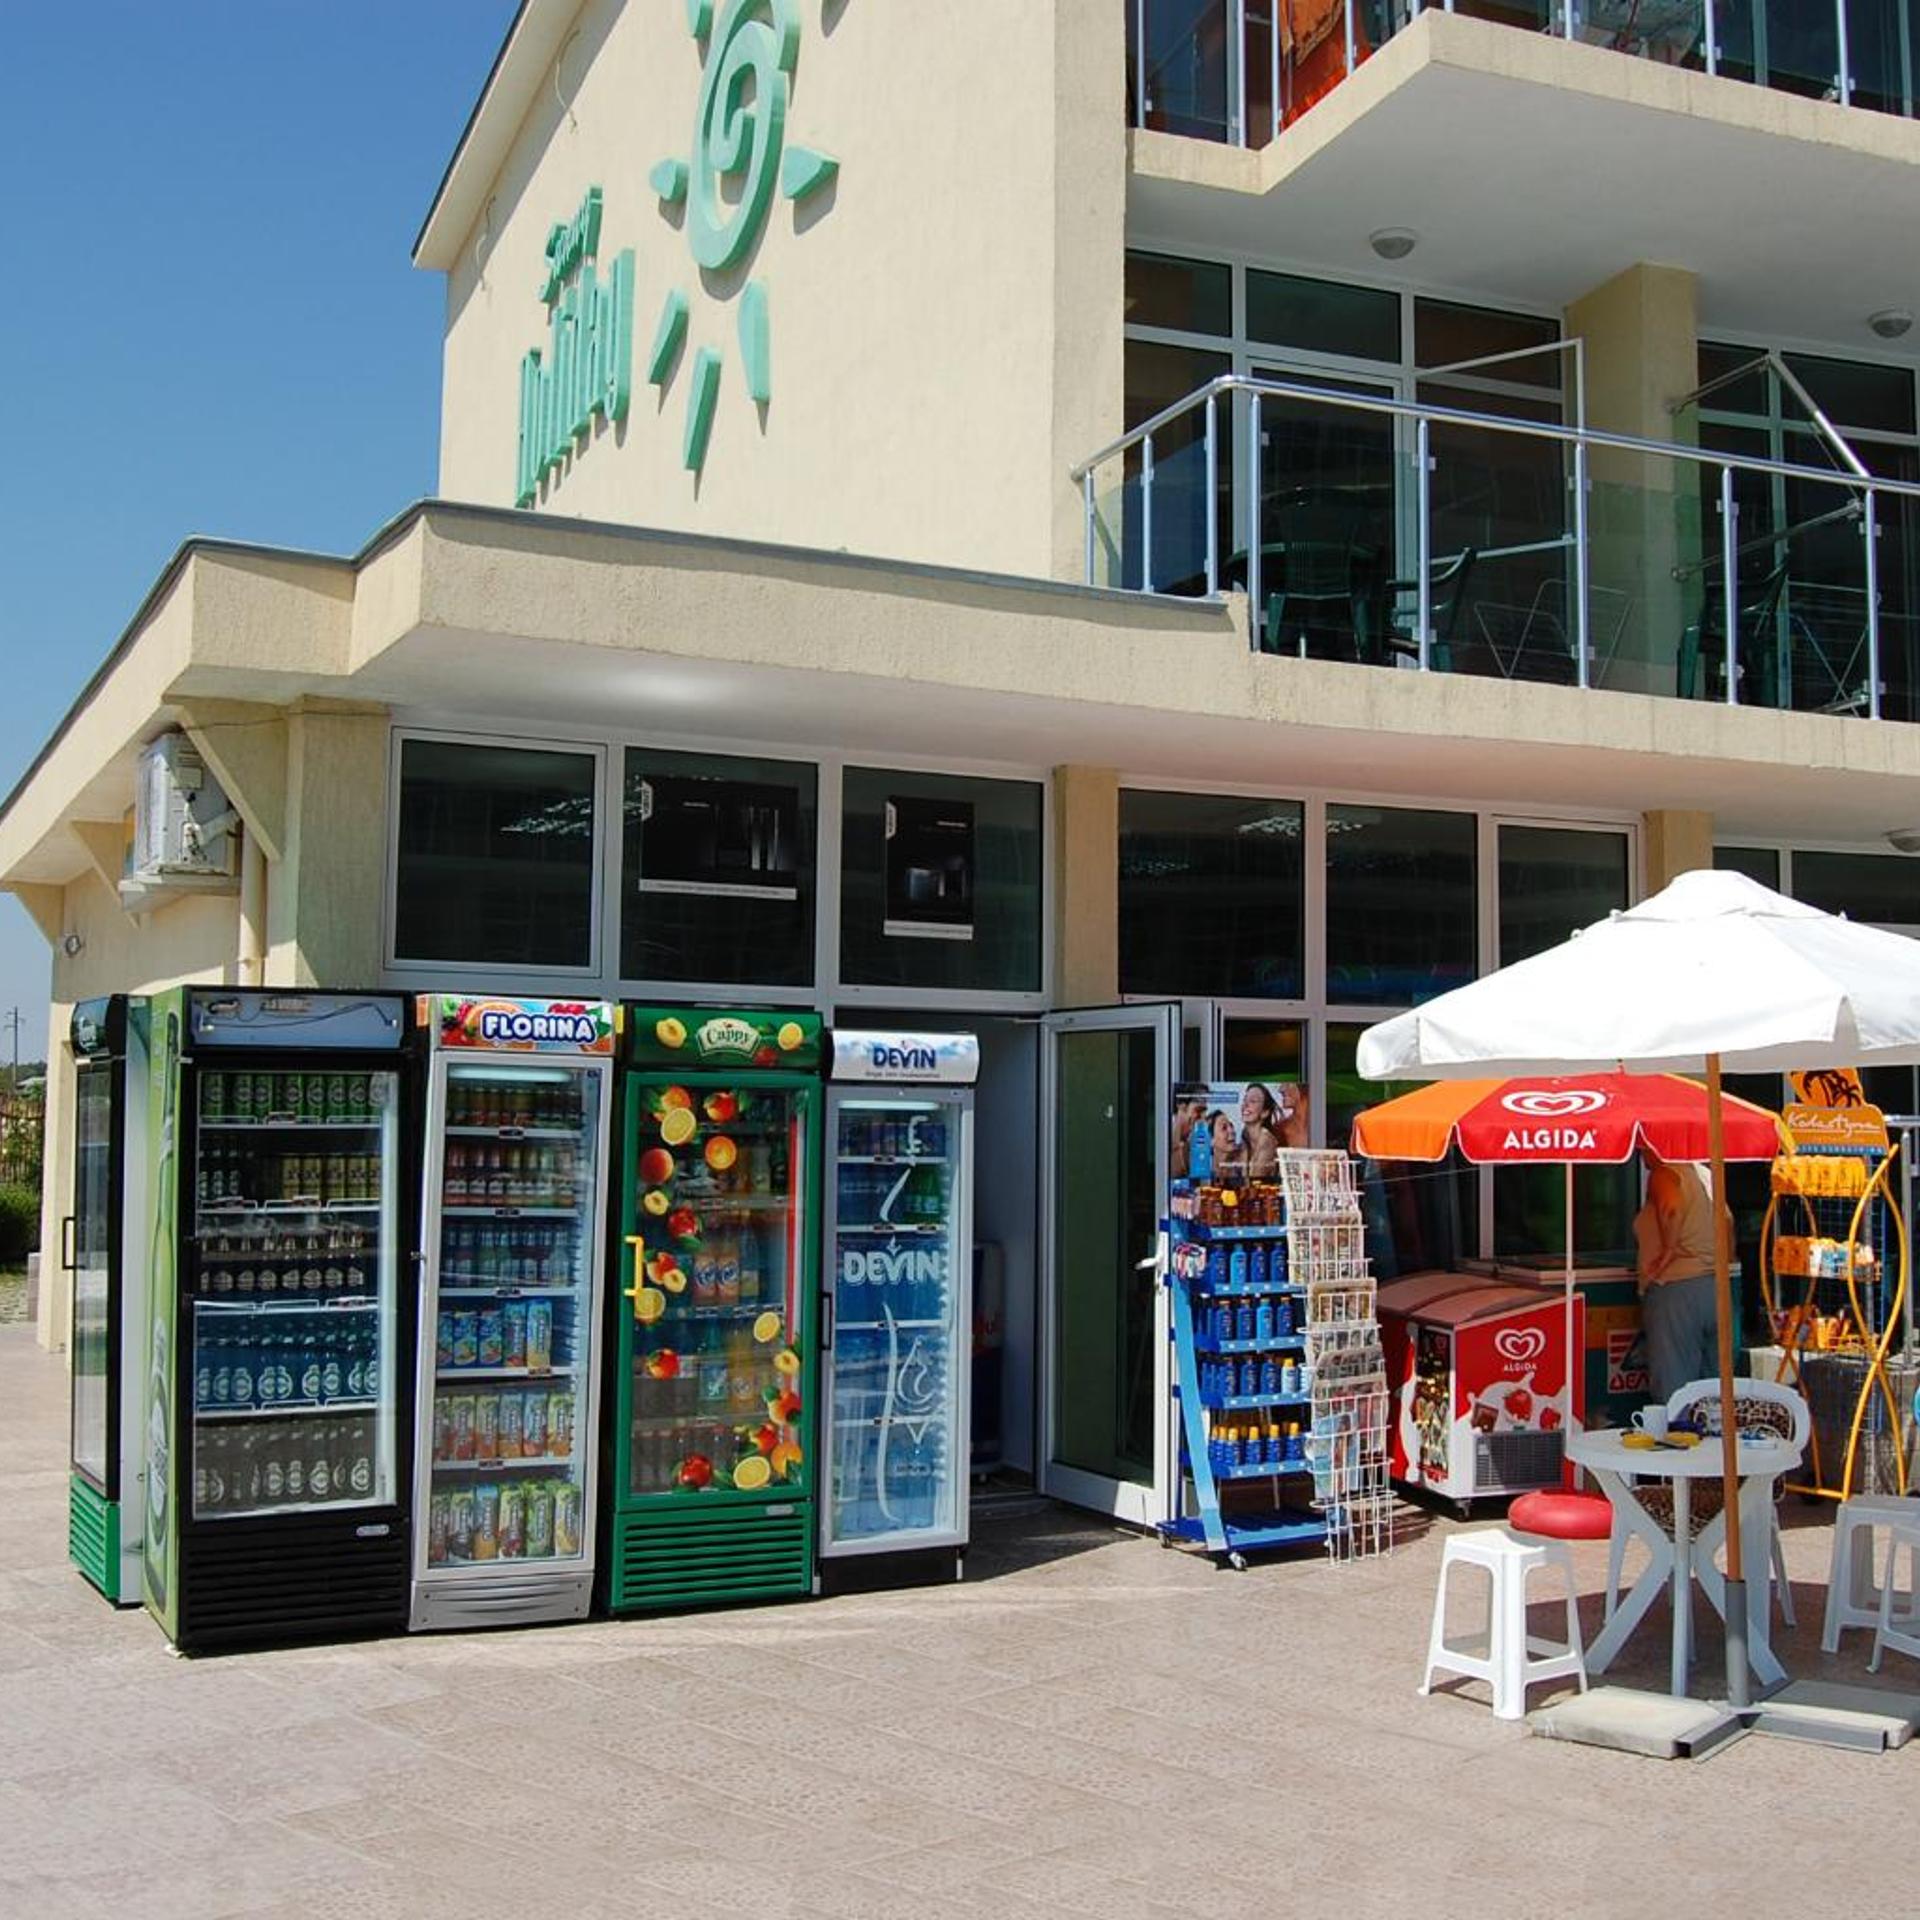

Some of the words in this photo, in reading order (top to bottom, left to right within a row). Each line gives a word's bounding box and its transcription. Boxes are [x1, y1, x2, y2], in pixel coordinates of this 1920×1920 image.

[482, 1013, 596, 1043] FLORINA
[706, 1027, 749, 1046] Cappy
[872, 1046, 936, 1069] DEVIN
[1503, 1128, 1596, 1150] ALGIDA
[842, 1249, 941, 1286] DEVIN
[1503, 1361, 1538, 1373] ALGIDA
